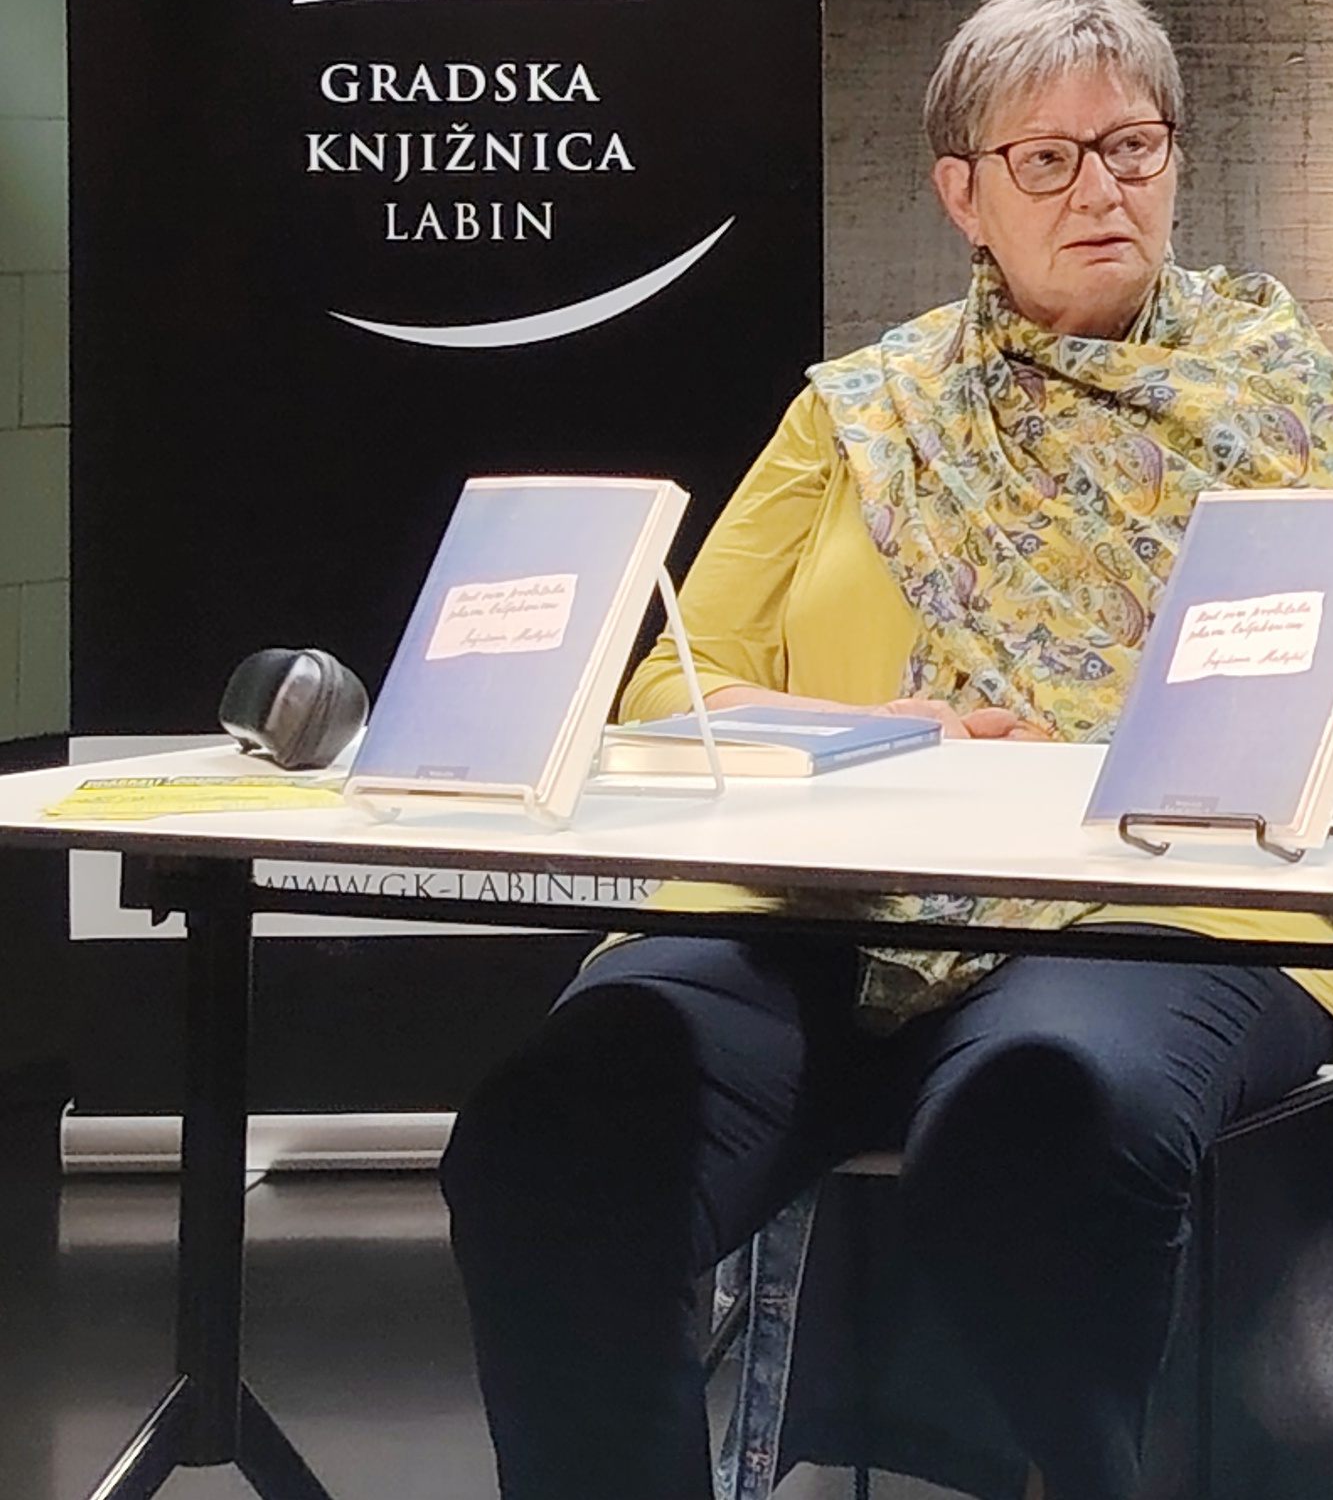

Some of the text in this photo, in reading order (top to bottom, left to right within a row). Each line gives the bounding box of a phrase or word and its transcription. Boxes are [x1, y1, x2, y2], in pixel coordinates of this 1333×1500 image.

[320, 62, 601, 103] GRADSKA
[305, 122, 636, 182] KNJIŽNICA
[384, 201, 554, 241] LABIN
